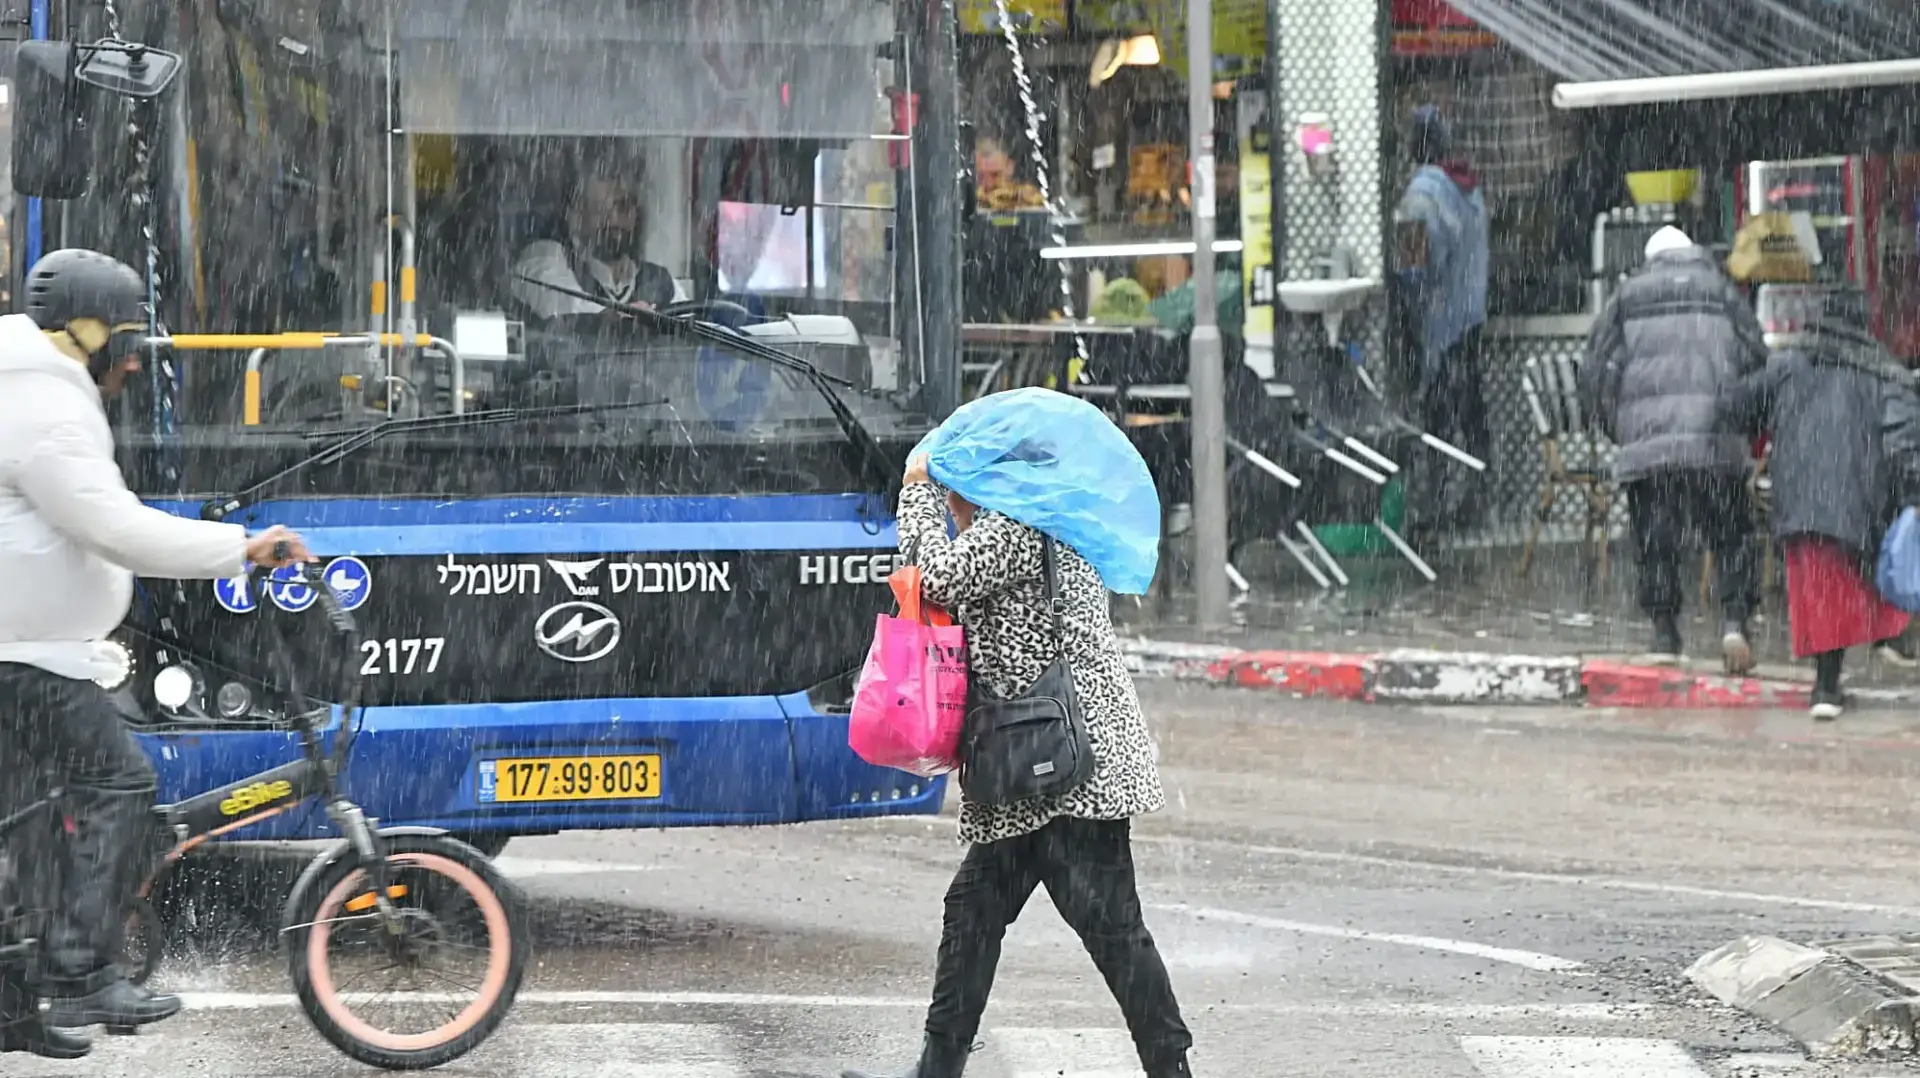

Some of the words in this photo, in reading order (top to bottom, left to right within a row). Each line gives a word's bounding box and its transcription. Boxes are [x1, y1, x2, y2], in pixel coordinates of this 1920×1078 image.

[436, 553, 541, 595] חשמלי
[578, 585, 600, 596] DAN
[608, 561, 731, 593] אוטובוס
[360, 637, 445, 675] 2177
